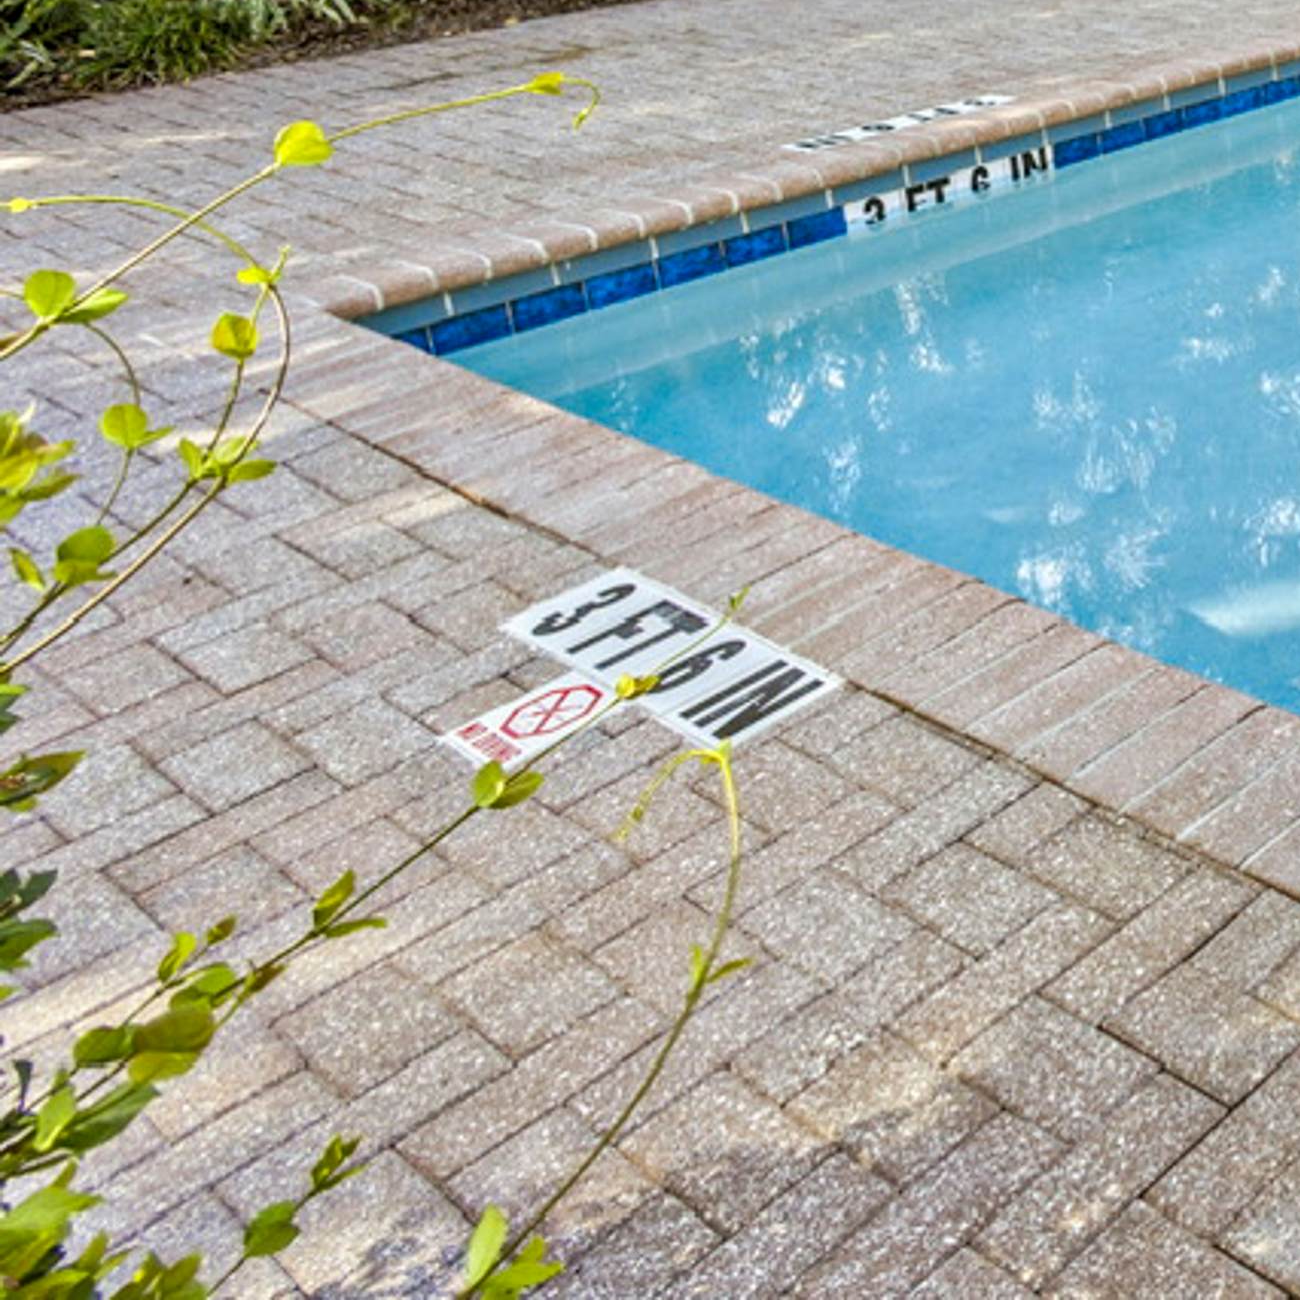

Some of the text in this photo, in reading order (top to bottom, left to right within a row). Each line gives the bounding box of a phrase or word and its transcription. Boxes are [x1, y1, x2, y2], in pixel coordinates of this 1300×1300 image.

[863, 147, 1048, 225] 3 FT 6 IN
[531, 583, 825, 740] 3 FT 6 IN
[455, 721, 489, 740] NO
